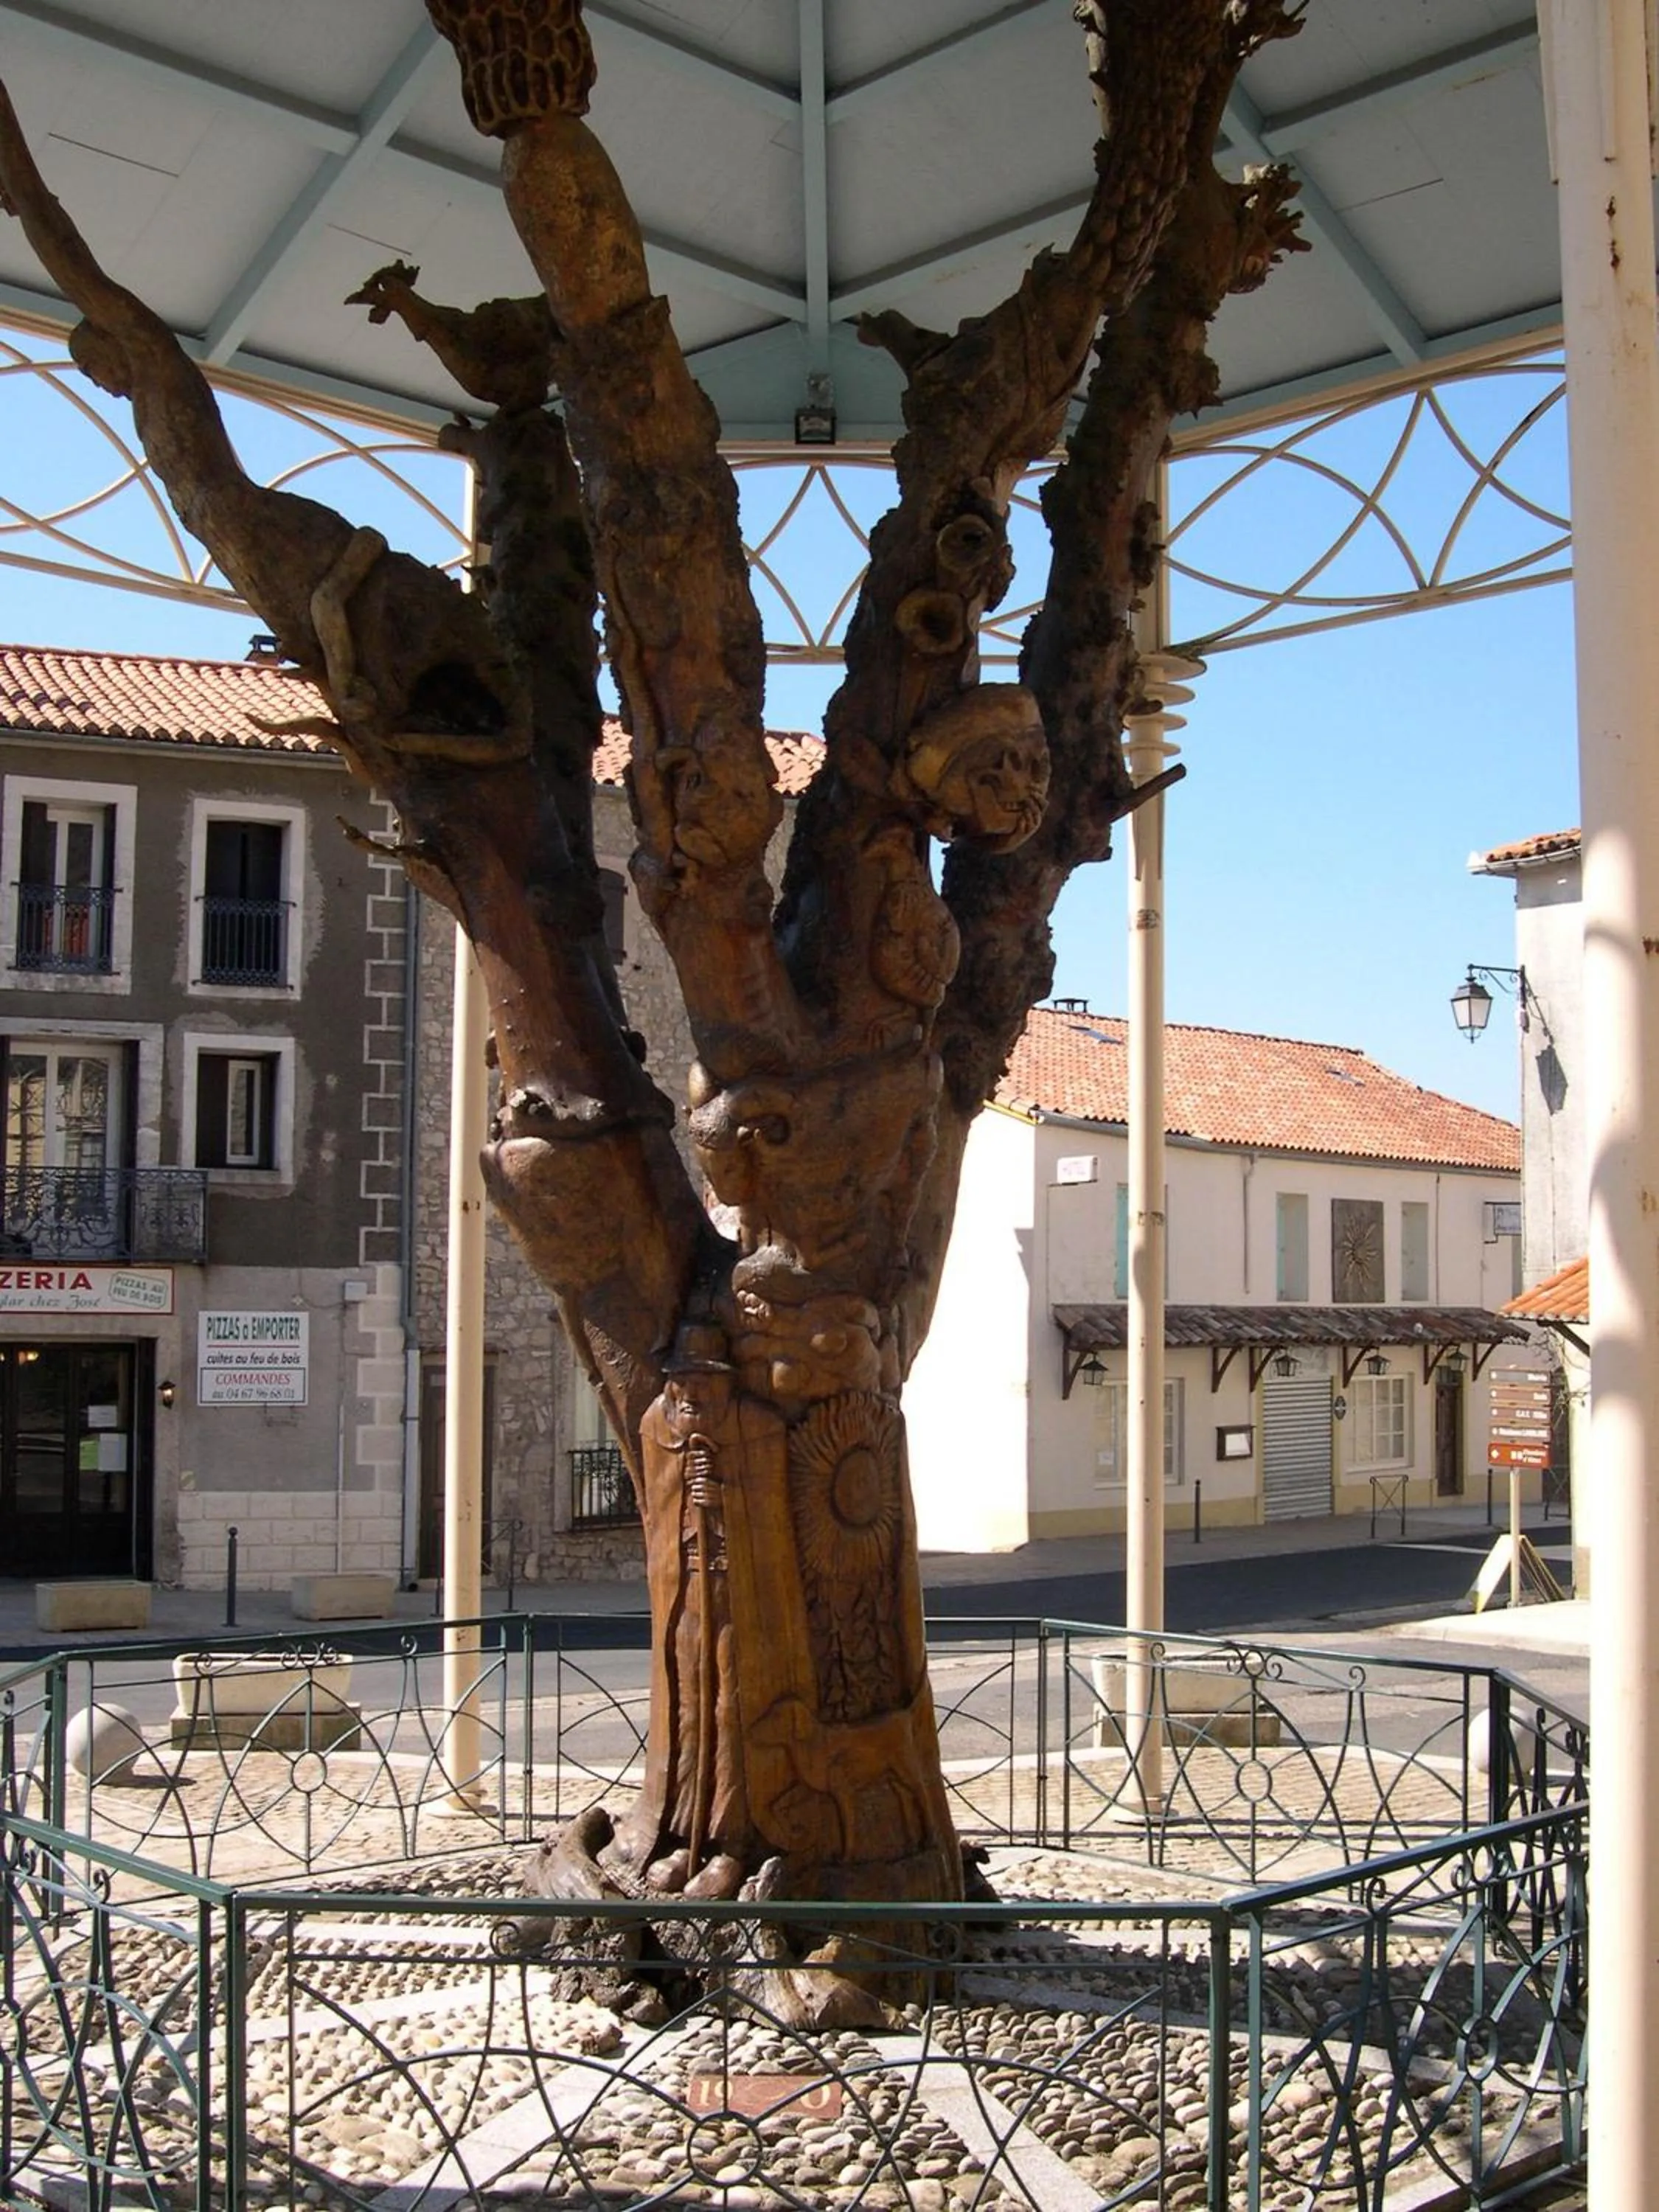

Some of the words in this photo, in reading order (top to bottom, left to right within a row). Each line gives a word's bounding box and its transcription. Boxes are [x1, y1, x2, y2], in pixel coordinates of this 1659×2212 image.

[0, 1272, 92, 1290] ZERIA
[29, 1295, 60, 1307] chez
[206, 1316, 240, 1340] PIZZAS
[251, 1316, 300, 1340] EMPORTER
[206, 1351, 234, 1364] cuites
[235, 1355, 248, 1364] au
[249, 1352, 265, 1365] feu
[266, 1352, 279, 1364] de
[281, 1352, 300, 1364] bois
[215, 1373, 291, 1385] COMMANDES
